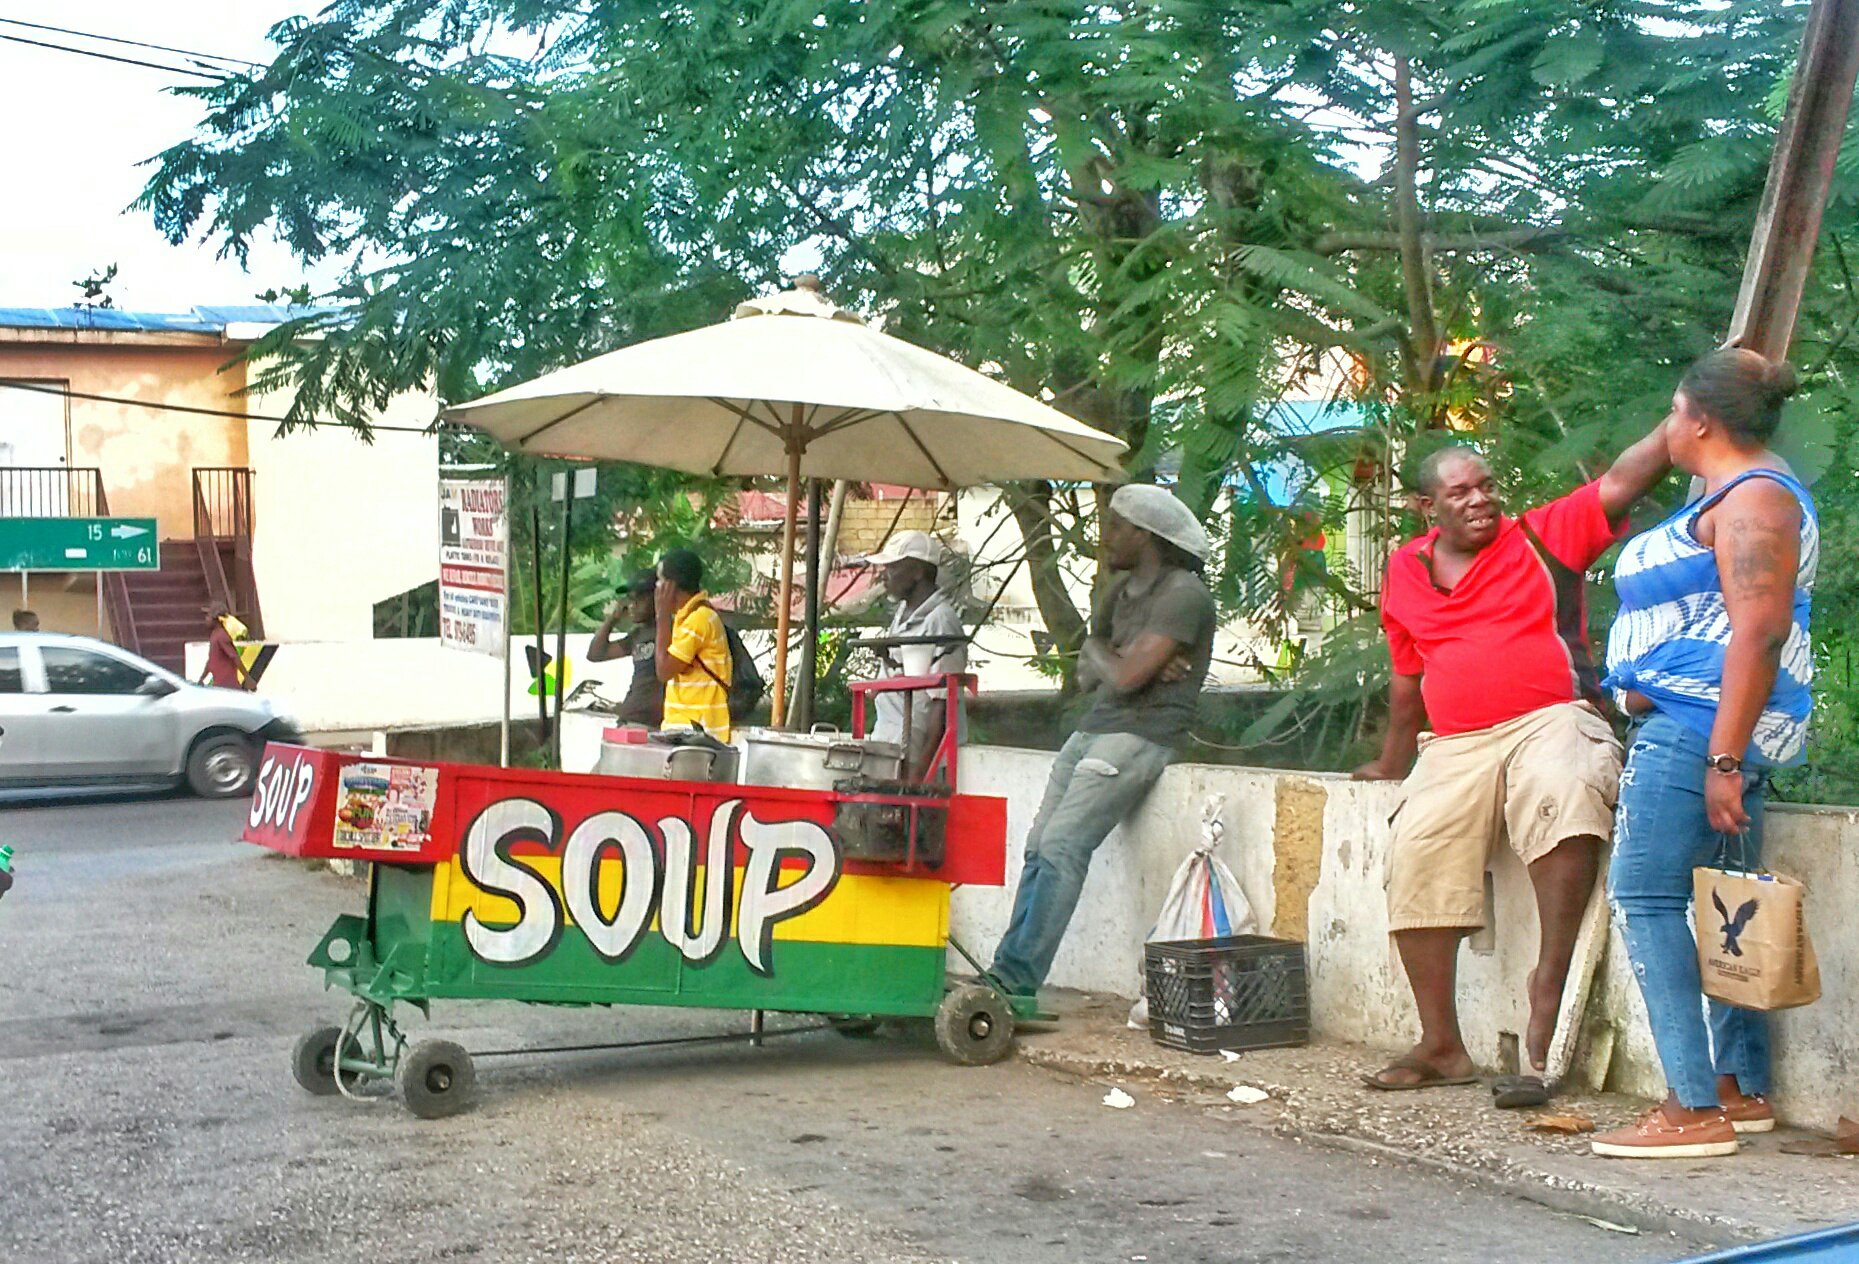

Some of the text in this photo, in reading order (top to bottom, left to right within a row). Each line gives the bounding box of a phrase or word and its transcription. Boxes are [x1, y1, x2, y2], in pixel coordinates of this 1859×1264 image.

[88, 524, 103, 541] 15
[137, 547, 152, 563] 61
[250, 751, 313, 832] SOUP
[461, 798, 839, 976] SOUP
